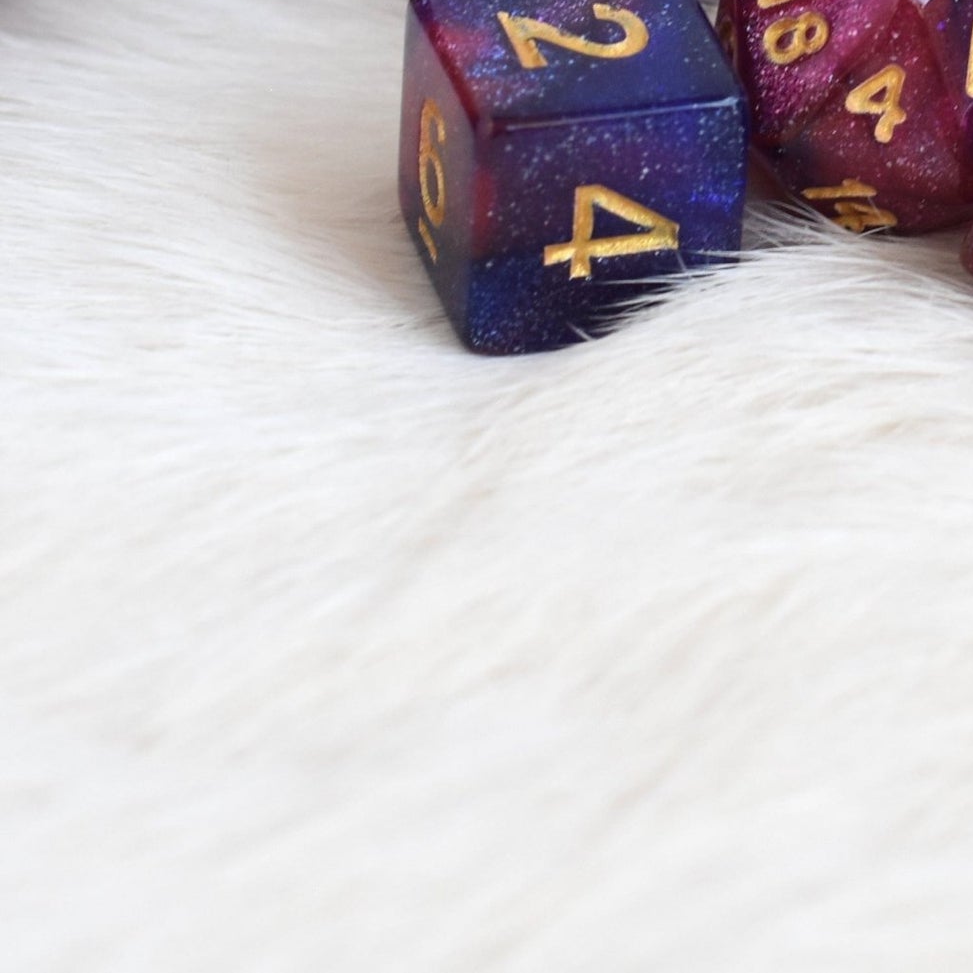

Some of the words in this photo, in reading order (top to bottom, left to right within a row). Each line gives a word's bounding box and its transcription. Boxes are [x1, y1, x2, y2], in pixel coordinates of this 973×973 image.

[497, 2, 650, 70] 2
[845, 64, 906, 143] 4
[543, 184, 680, 281] 4
